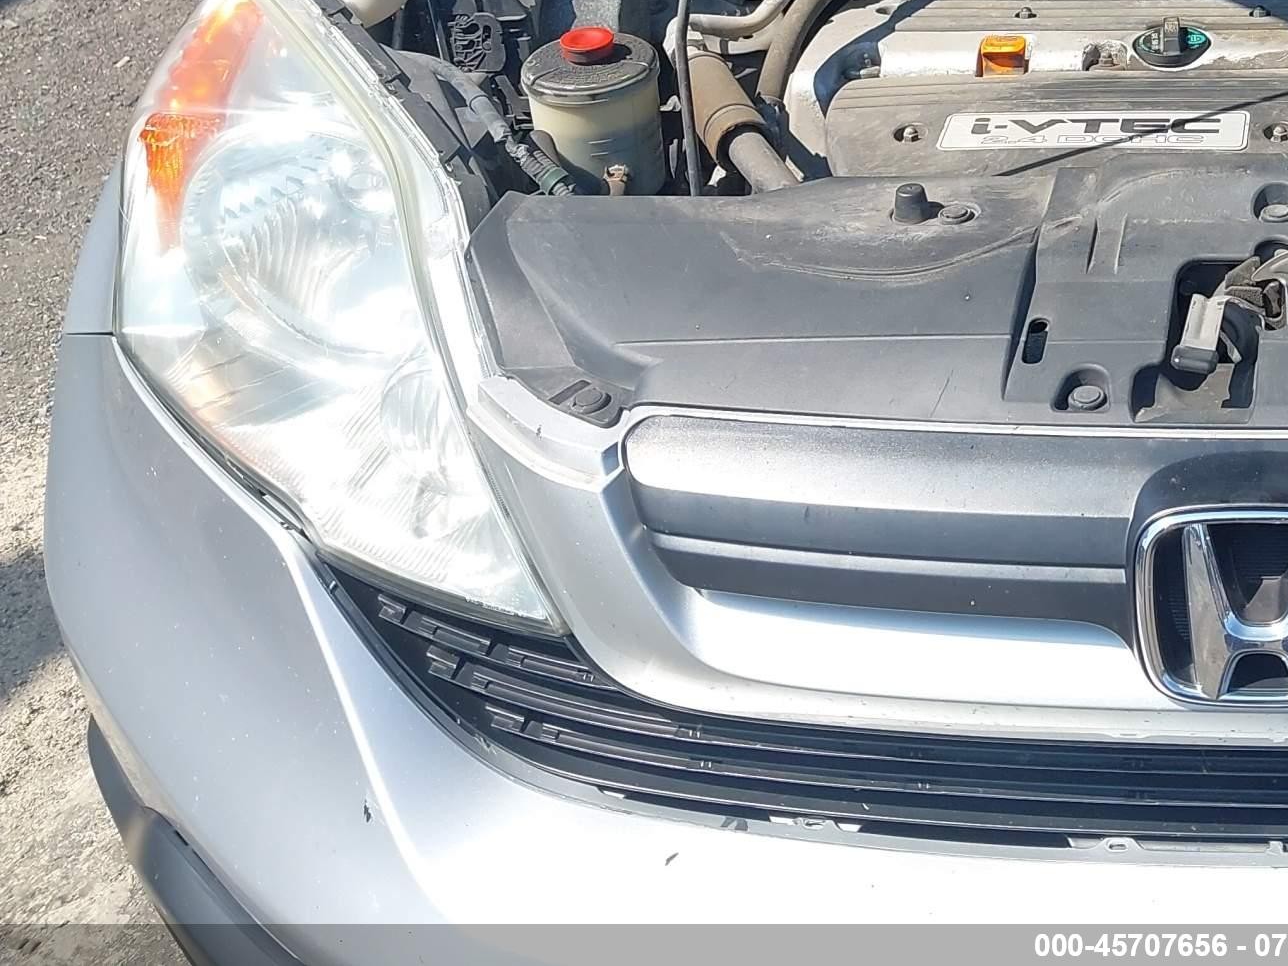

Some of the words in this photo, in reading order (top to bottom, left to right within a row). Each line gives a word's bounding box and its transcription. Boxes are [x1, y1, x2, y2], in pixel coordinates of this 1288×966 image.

[971, 118, 1221, 134] i-VTEC
[981, 135, 1048, 144] 2.4
[1057, 135, 1204, 144] DOHC
